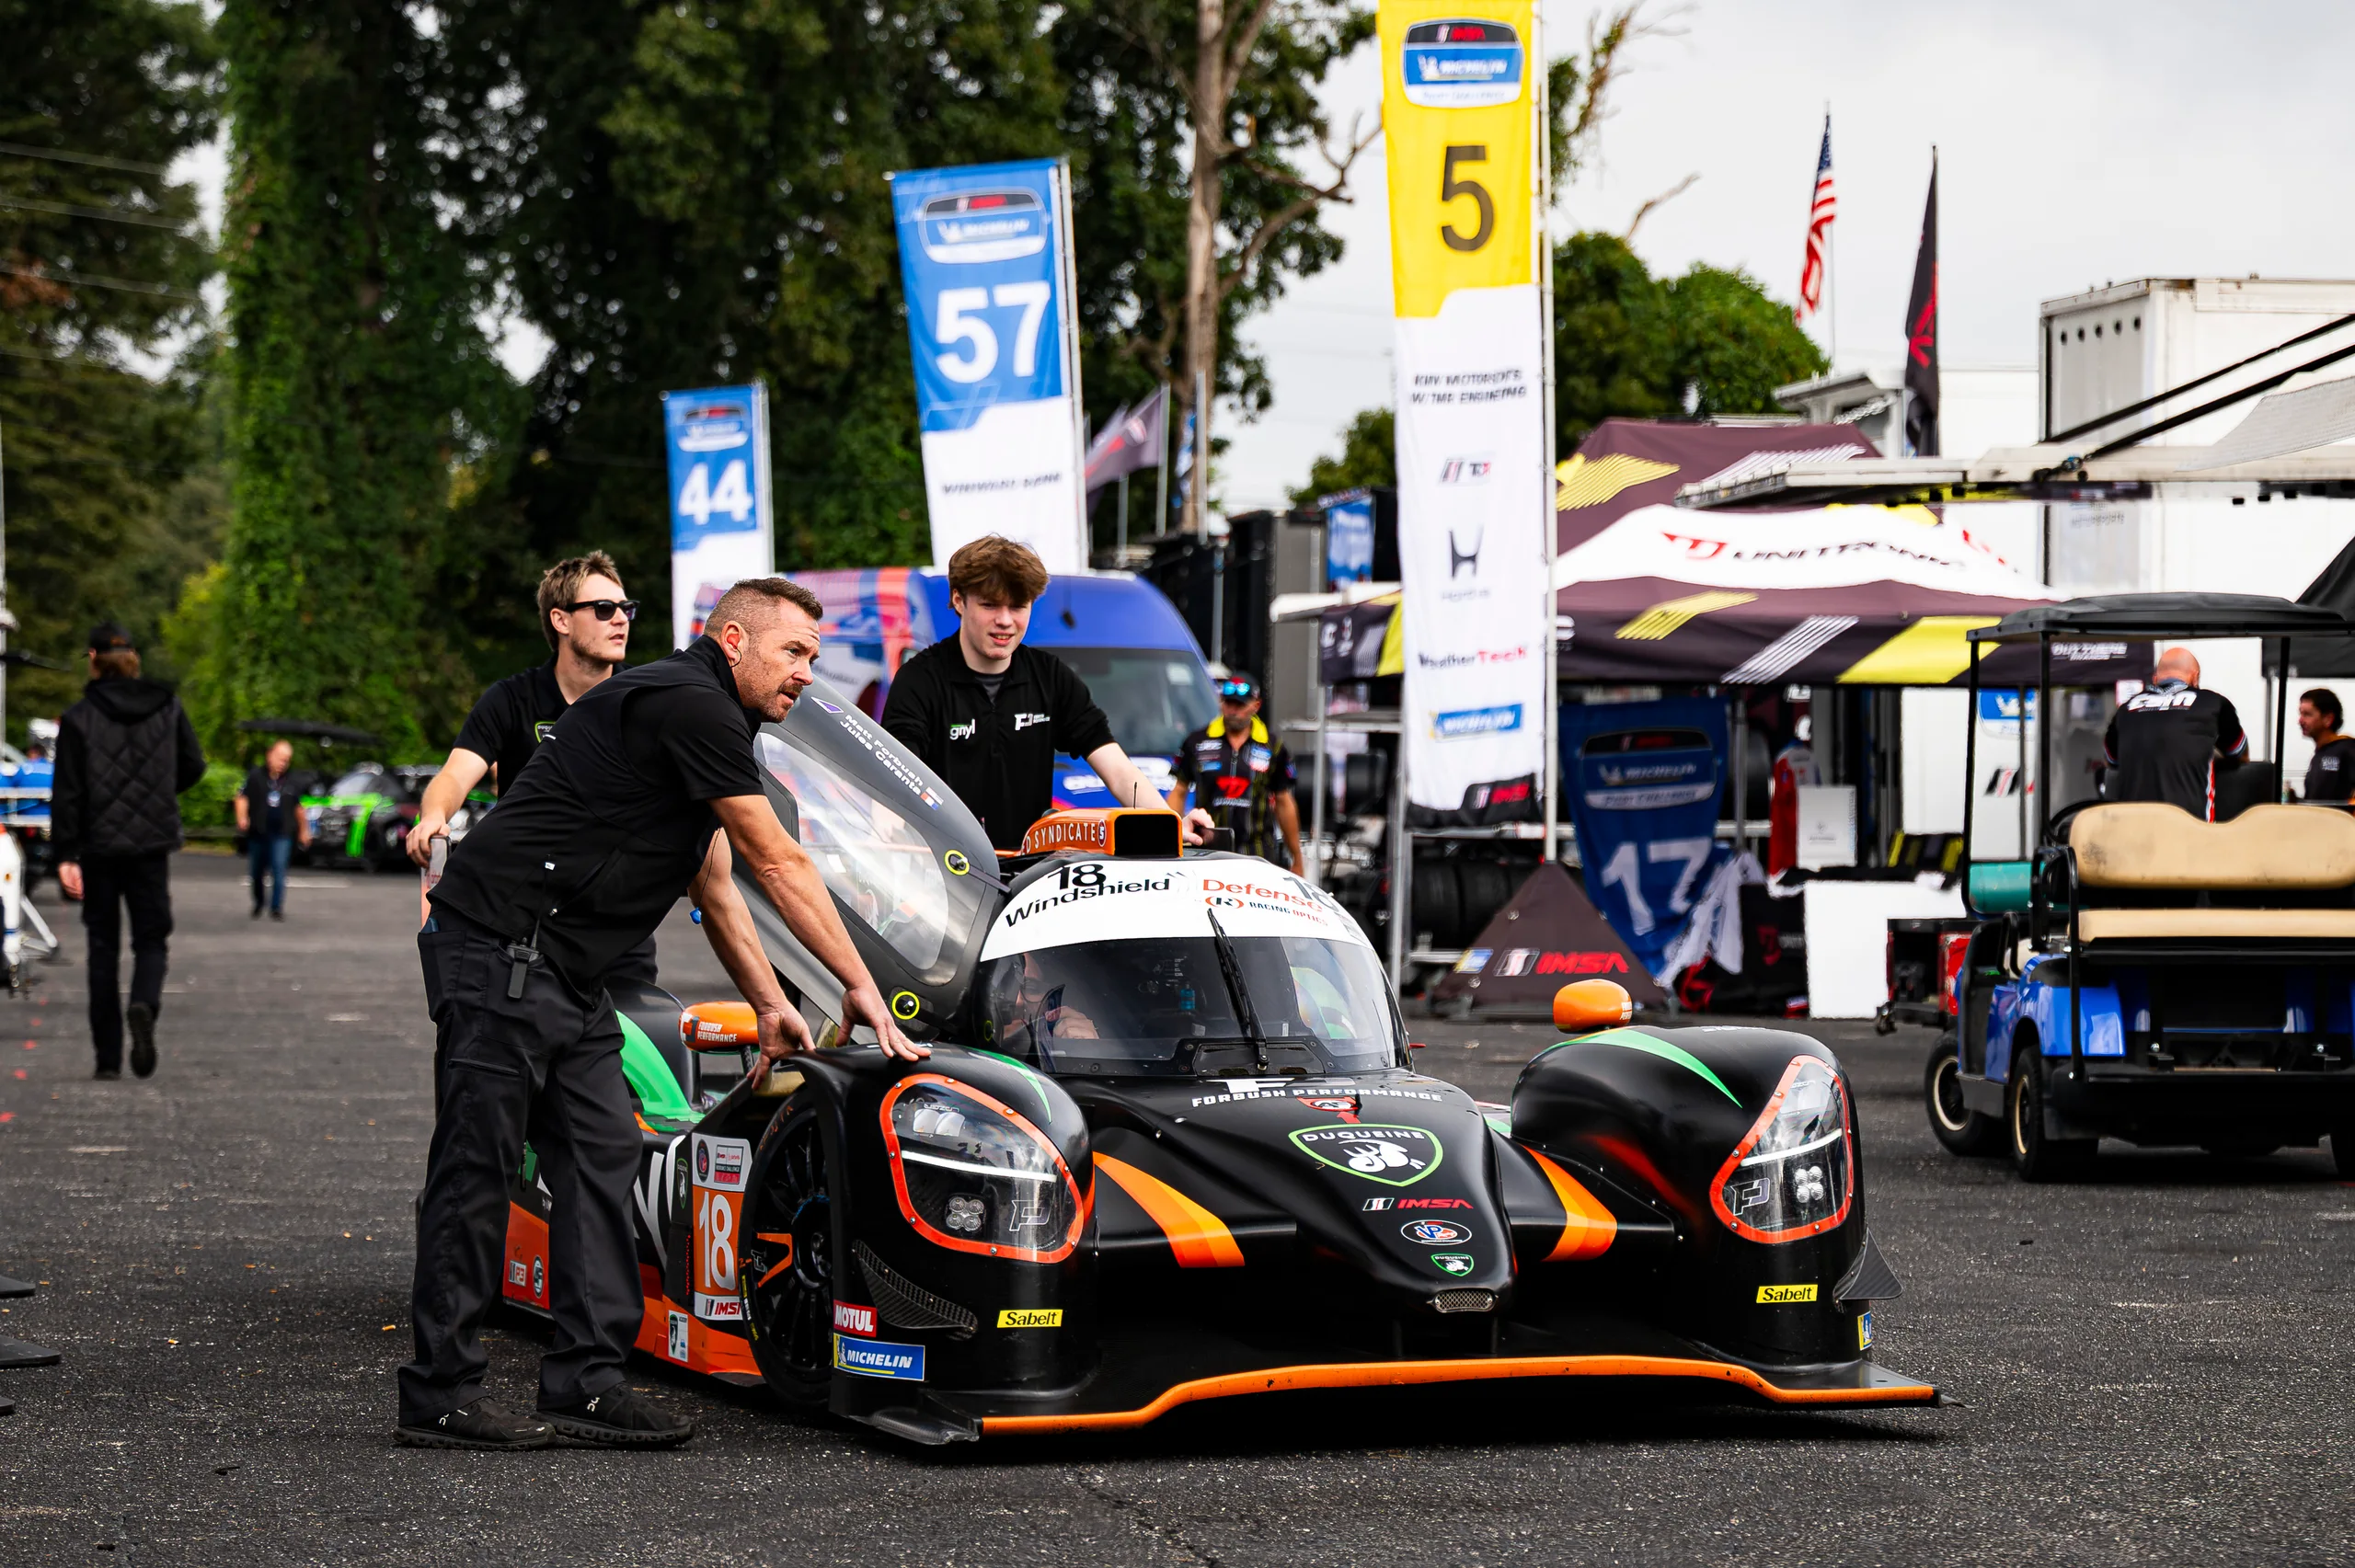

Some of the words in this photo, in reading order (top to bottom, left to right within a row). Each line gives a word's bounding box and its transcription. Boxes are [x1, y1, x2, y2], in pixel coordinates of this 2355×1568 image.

[1441, 145, 1494, 252] 5
[935, 280, 1051, 384] 57
[677, 459, 754, 526] 44
[839, 720, 873, 750] Jules
[875, 750, 922, 795] Caranta
[844, 715, 873, 740] Matt
[874, 739, 924, 786] Forbush
[1625, 763, 1697, 780] MICHELIN
[1034, 822, 1096, 849] SYNDICATE
[1047, 864, 1107, 890] 18
[1602, 837, 1714, 936] 17
[1005, 878, 1170, 928] Windshield
[1203, 878, 1323, 912] Defense
[1248, 901, 1291, 914] RACING
[1292, 909, 1328, 927] OPTICS
[1534, 950, 1630, 975] IMSA
[697, 1030, 738, 1042] PERFORMANCE
[1191, 1089, 1286, 1108] FORBUSH
[1292, 1088, 1443, 1102] PERFORMANCE
[1302, 1130, 1426, 1142] DUQUEINE
[1396, 1198, 1474, 1209] IMSA
[698, 1191, 736, 1291] 18
[1414, 1224, 1443, 1240] VP
[1761, 1287, 1813, 1302] Sabelt
[714, 1301, 741, 1316] IMS
[834, 1304, 875, 1333] MOTUL
[1005, 1311, 1057, 1326] Sabelt
[846, 1349, 913, 1369] MICHELIN
